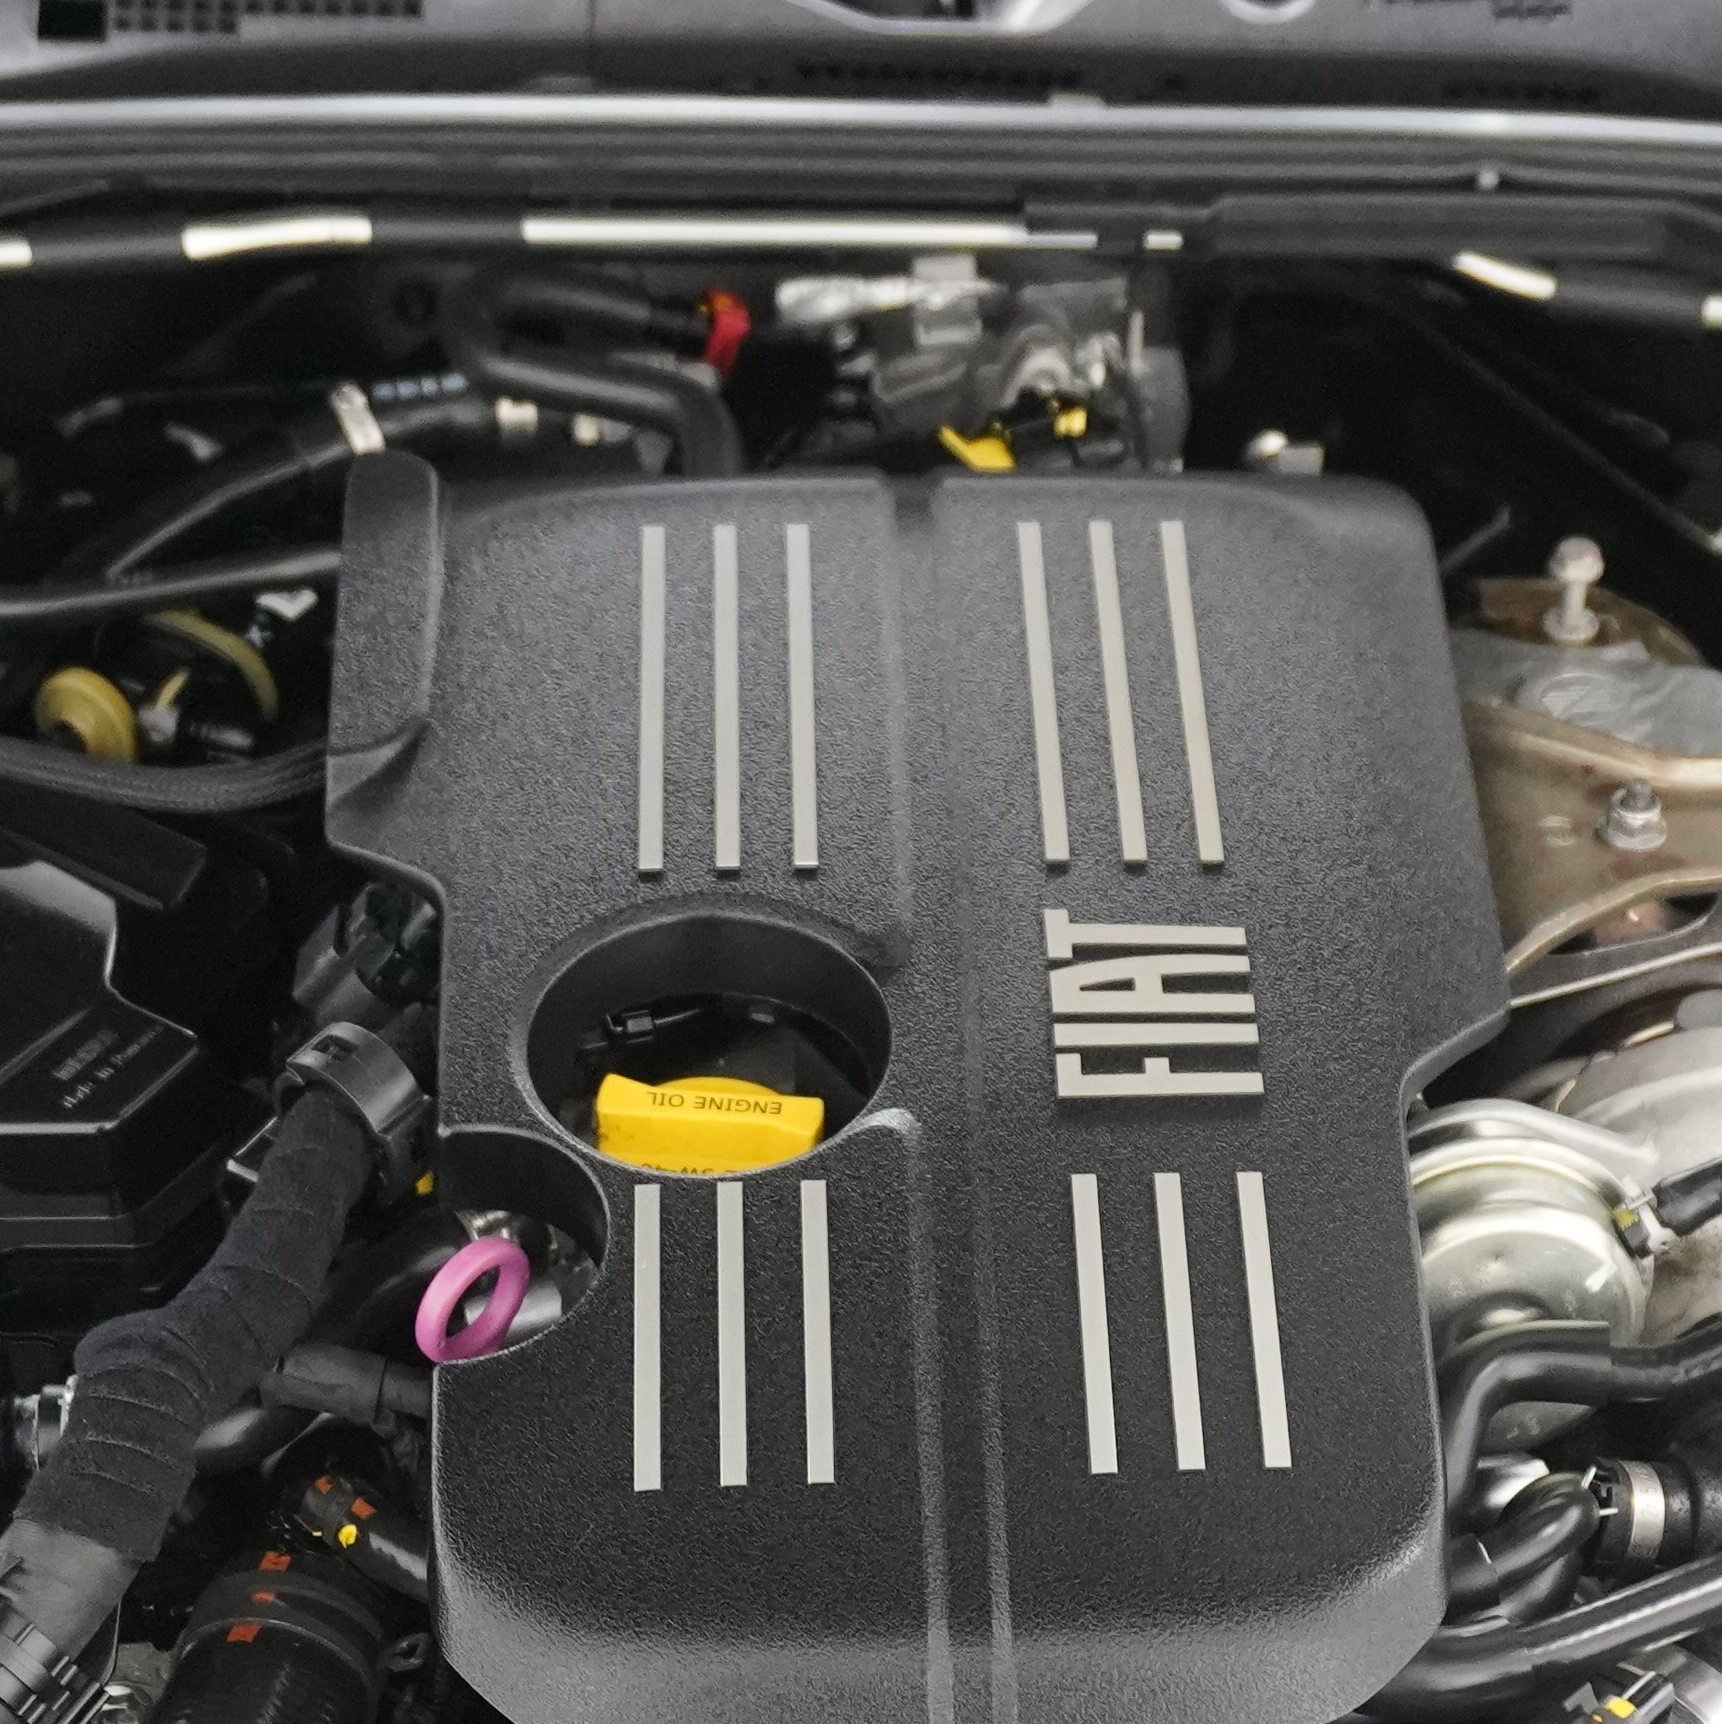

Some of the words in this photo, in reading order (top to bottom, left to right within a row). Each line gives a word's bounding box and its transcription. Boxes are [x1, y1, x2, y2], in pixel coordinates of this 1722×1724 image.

[1043, 907, 1266, 1100] FIAT
[645, 1091, 684, 1109] OIL
[693, 1095, 783, 1115] ENGINE
